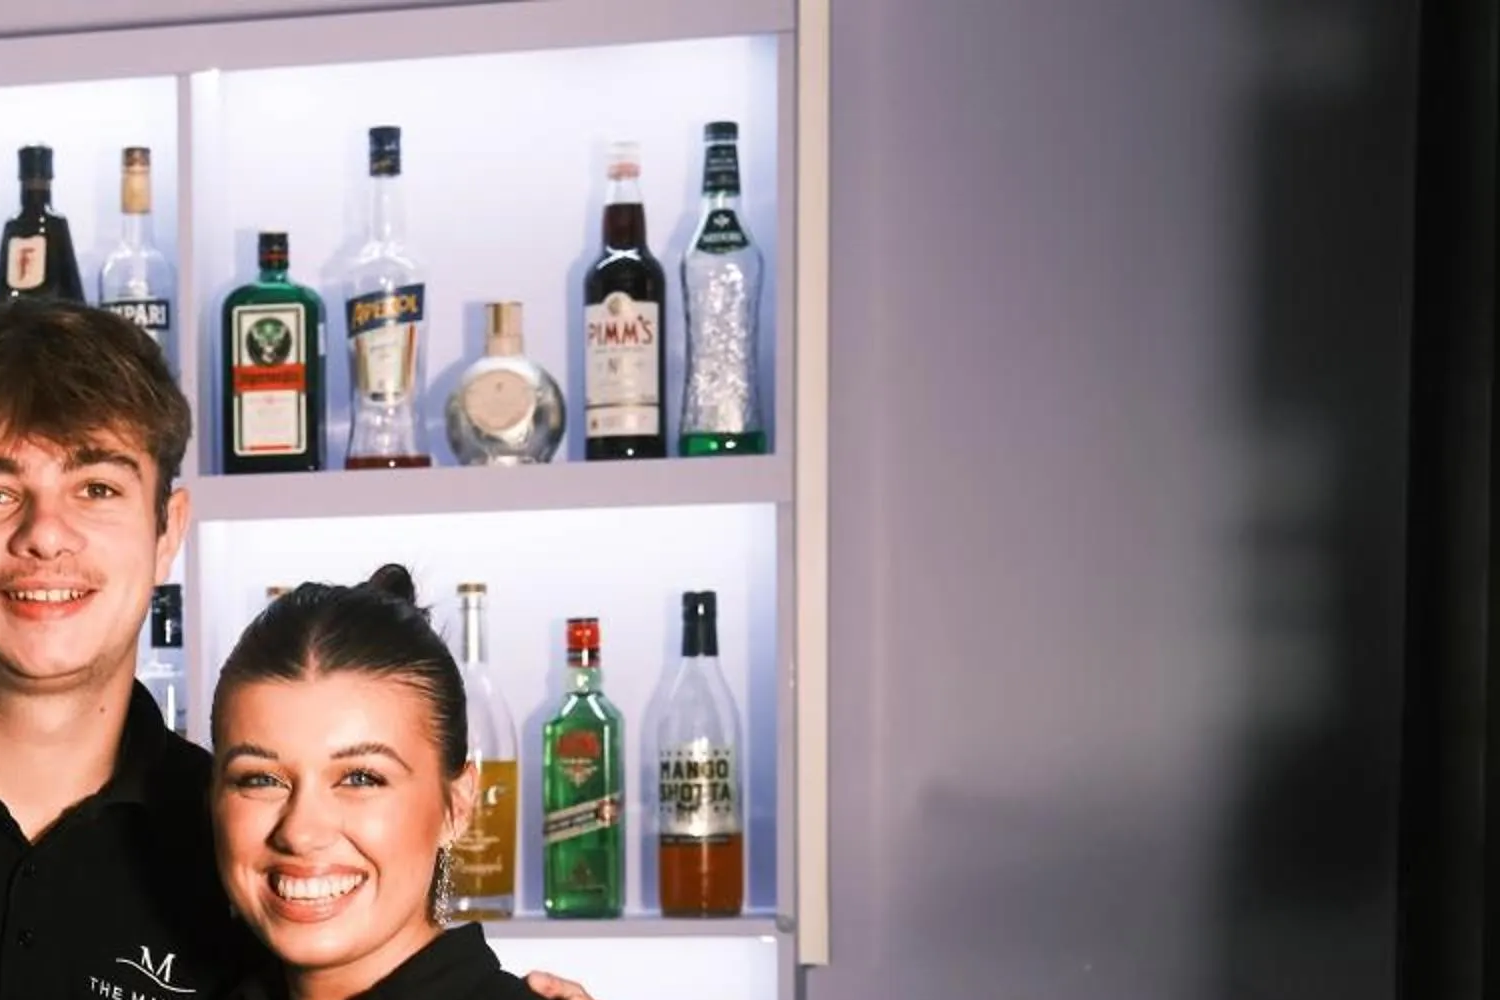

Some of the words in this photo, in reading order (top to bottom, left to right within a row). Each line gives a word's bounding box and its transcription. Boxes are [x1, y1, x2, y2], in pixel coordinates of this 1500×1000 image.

[109, 303, 167, 326] PARI
[660, 758, 729, 780] MANGO
[139, 944, 177, 983] M
